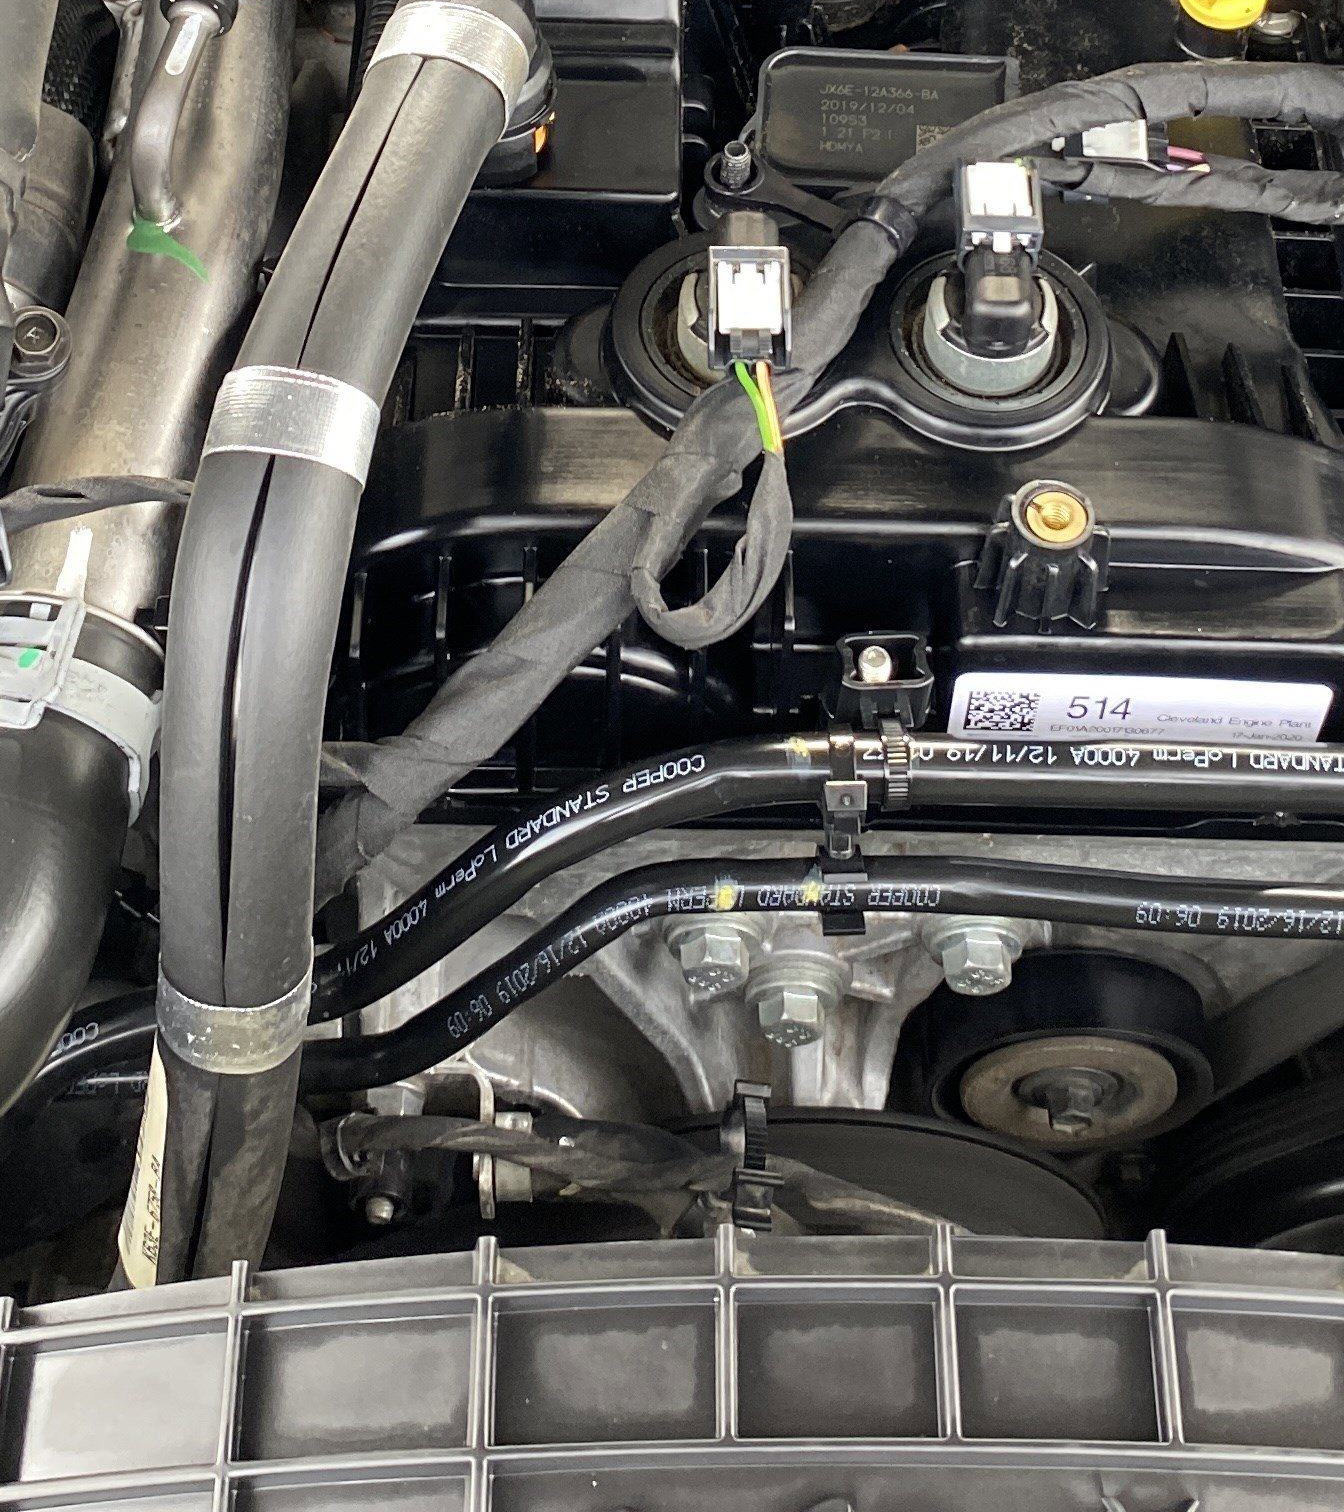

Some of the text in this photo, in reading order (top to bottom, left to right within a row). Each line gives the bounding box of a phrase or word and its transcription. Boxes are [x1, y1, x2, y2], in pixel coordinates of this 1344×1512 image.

[820, 99, 915, 115] 2019/12/04
[1066, 696, 1132, 720] 514
[1156, 712, 1312, 729] Cleveland Engine Plant
[946, 745, 1058, 765] 12/11/19
[1070, 746, 1141, 767] 4000A
[1151, 746, 1237, 769] LoPerm
[622, 754, 707, 794] COOPER
[506, 784, 610, 850] STANDARD
[435, 842, 498, 899] LoPerm
[867, 884, 941, 907] COOPER
[383, 898, 428, 946] 4000A
[1135, 901, 1201, 928] 06:09
